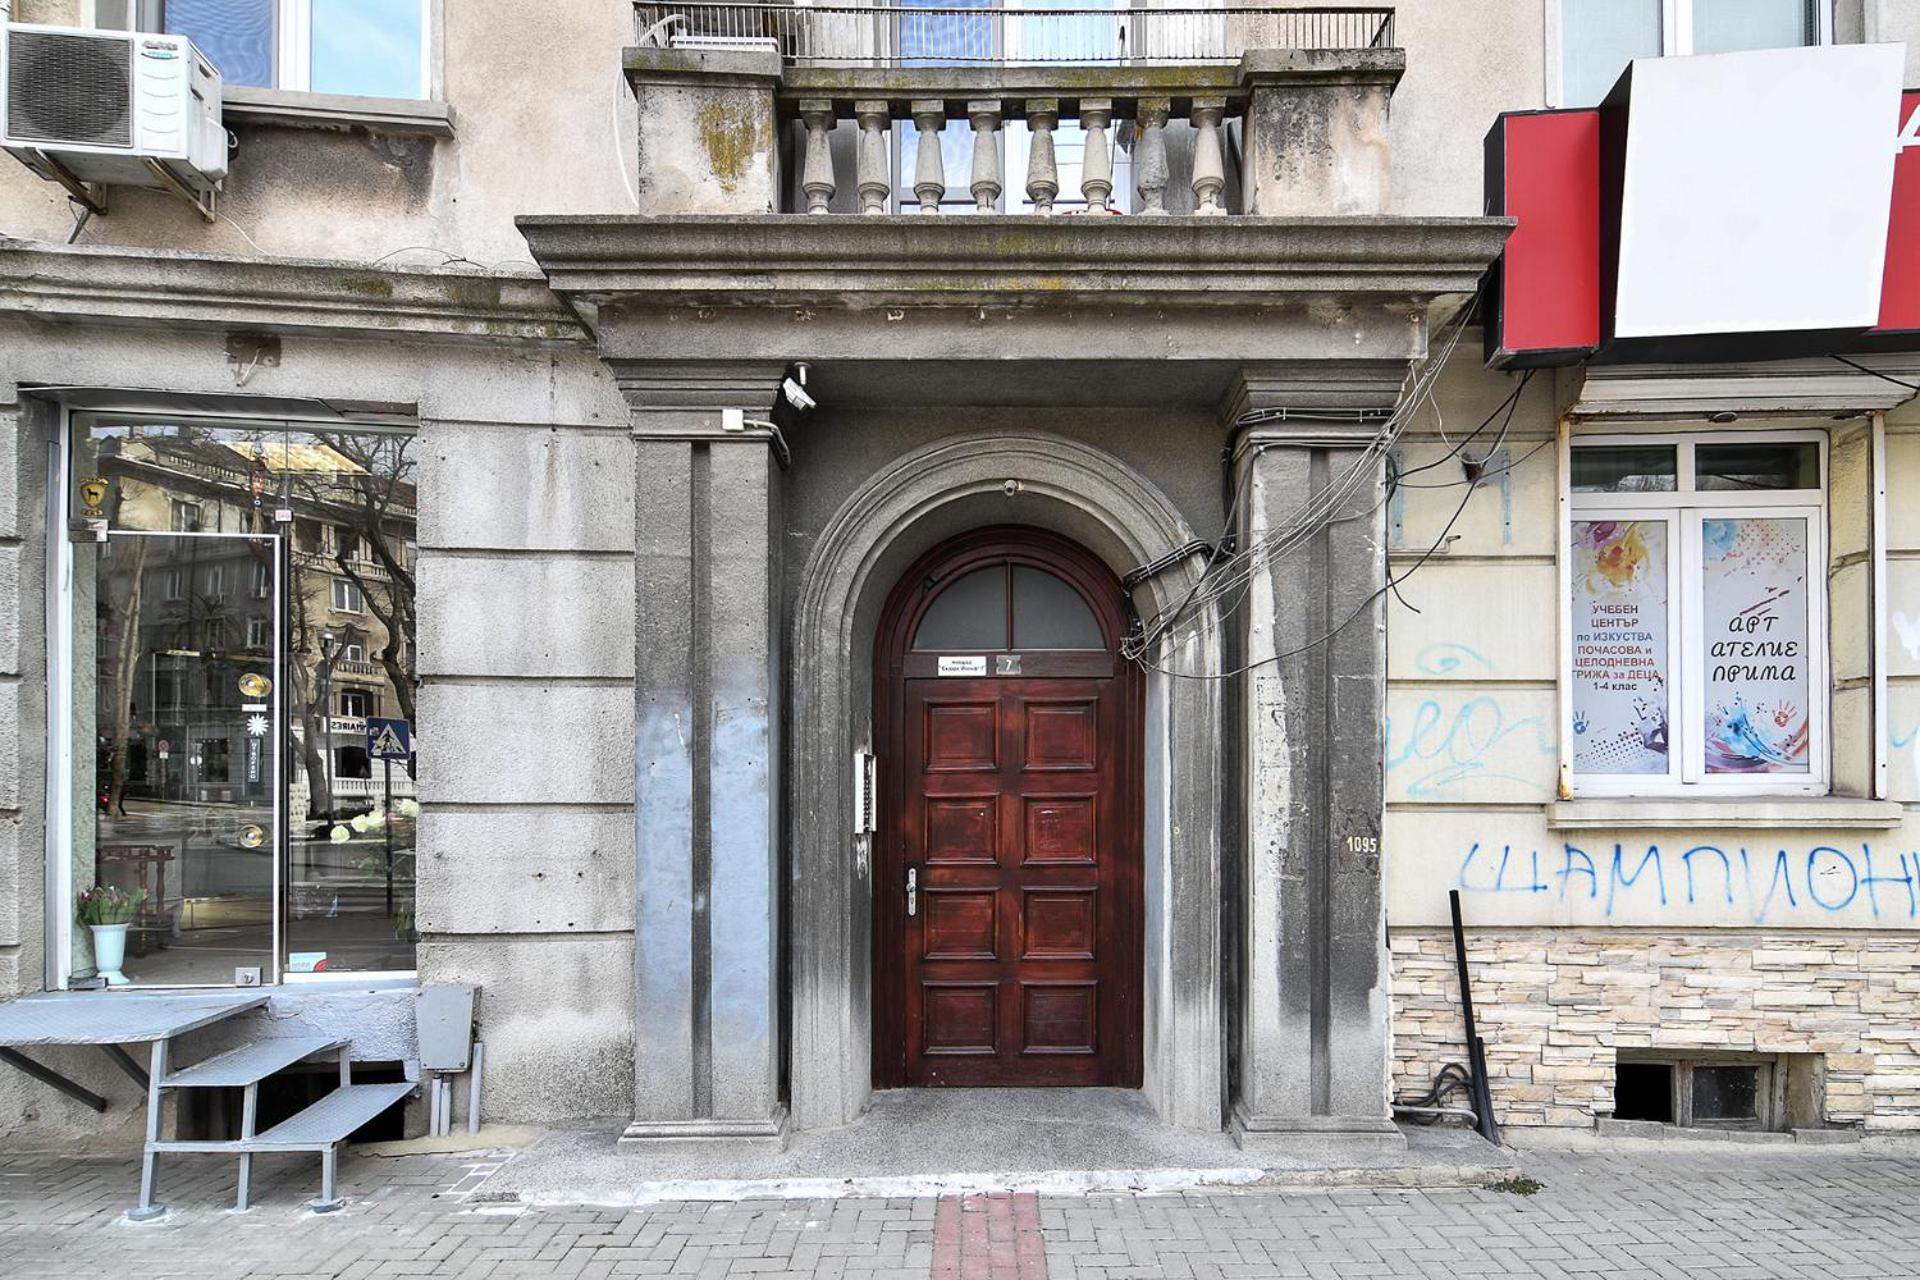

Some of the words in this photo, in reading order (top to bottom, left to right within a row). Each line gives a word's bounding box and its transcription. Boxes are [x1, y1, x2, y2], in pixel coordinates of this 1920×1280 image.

[1592, 604, 1638, 614] УЧЕБЕН
[1591, 618, 1639, 629] ЦЕНТЪР
[1593, 632, 1653, 641] ИЗКУСТВА
[1577, 645, 1641, 655] ПОЧАСОВА
[1006, 659, 1012, 671] 7
[1575, 657, 1655, 668] ЦЕЛОДНЕВНА
[1627, 670, 1660, 680] ДЕЦА
[1593, 682, 1609, 690] 1-4
[1612, 683, 1637, 691] клас
[1346, 836, 1377, 853] 1095
[1460, 843, 1920, 923] ШАМПИОН
